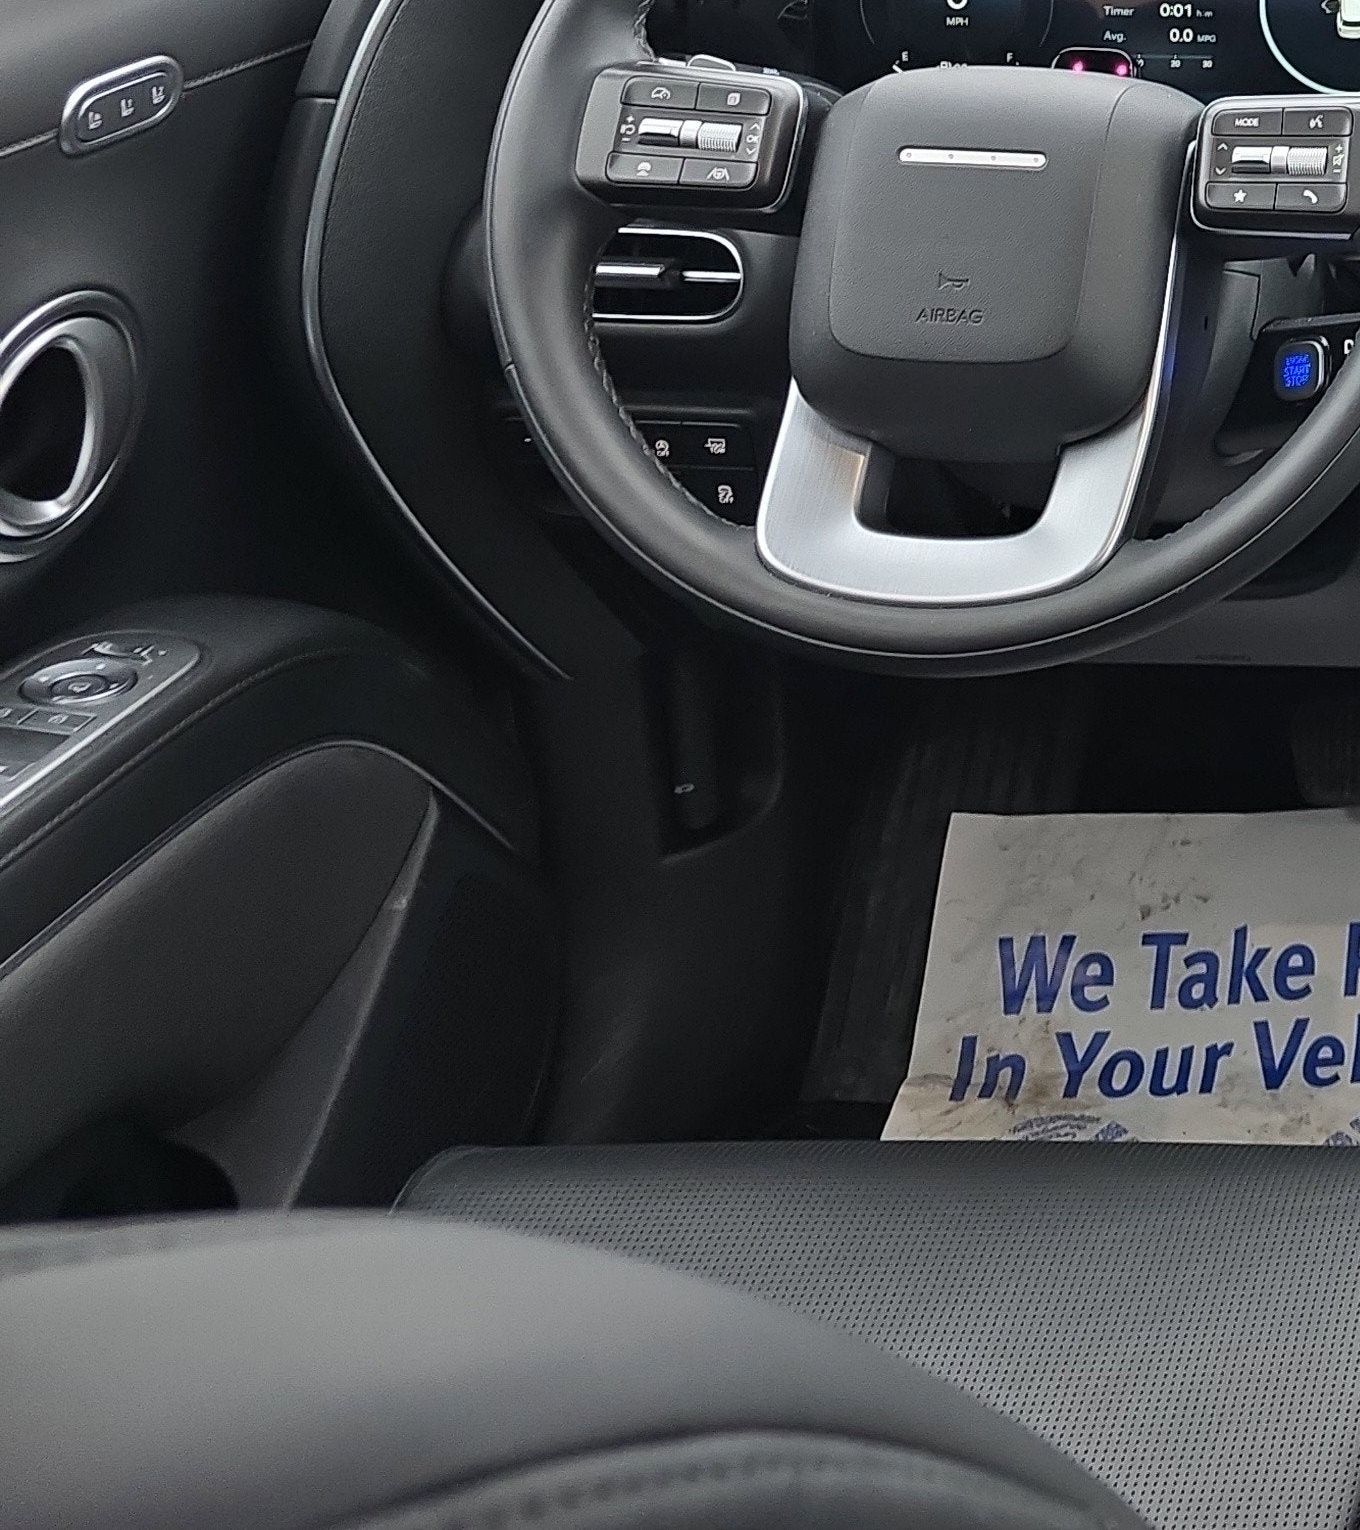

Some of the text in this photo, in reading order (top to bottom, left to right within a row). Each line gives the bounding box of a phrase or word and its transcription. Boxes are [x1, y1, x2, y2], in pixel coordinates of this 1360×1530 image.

[1103, 5, 1135, 16] Timer
[1159, 3, 1192, 17] 0:01
[946, 17, 969, 26] MPH
[1103, 28, 1217, 43] Avg. 0.0 MPG
[901, 51, 909, 62] E
[1006, 52, 1014, 63] F
[1235, 117, 1259, 127] MODE
[914, 307, 983, 326] AIRBAG
[1284, 363, 1311, 376] START
[998, 933, 1115, 1016] We
[1141, 924, 1316, 1011] Take
[948, 1034, 1027, 1102] In
[1055, 1030, 1234, 1100] Your
